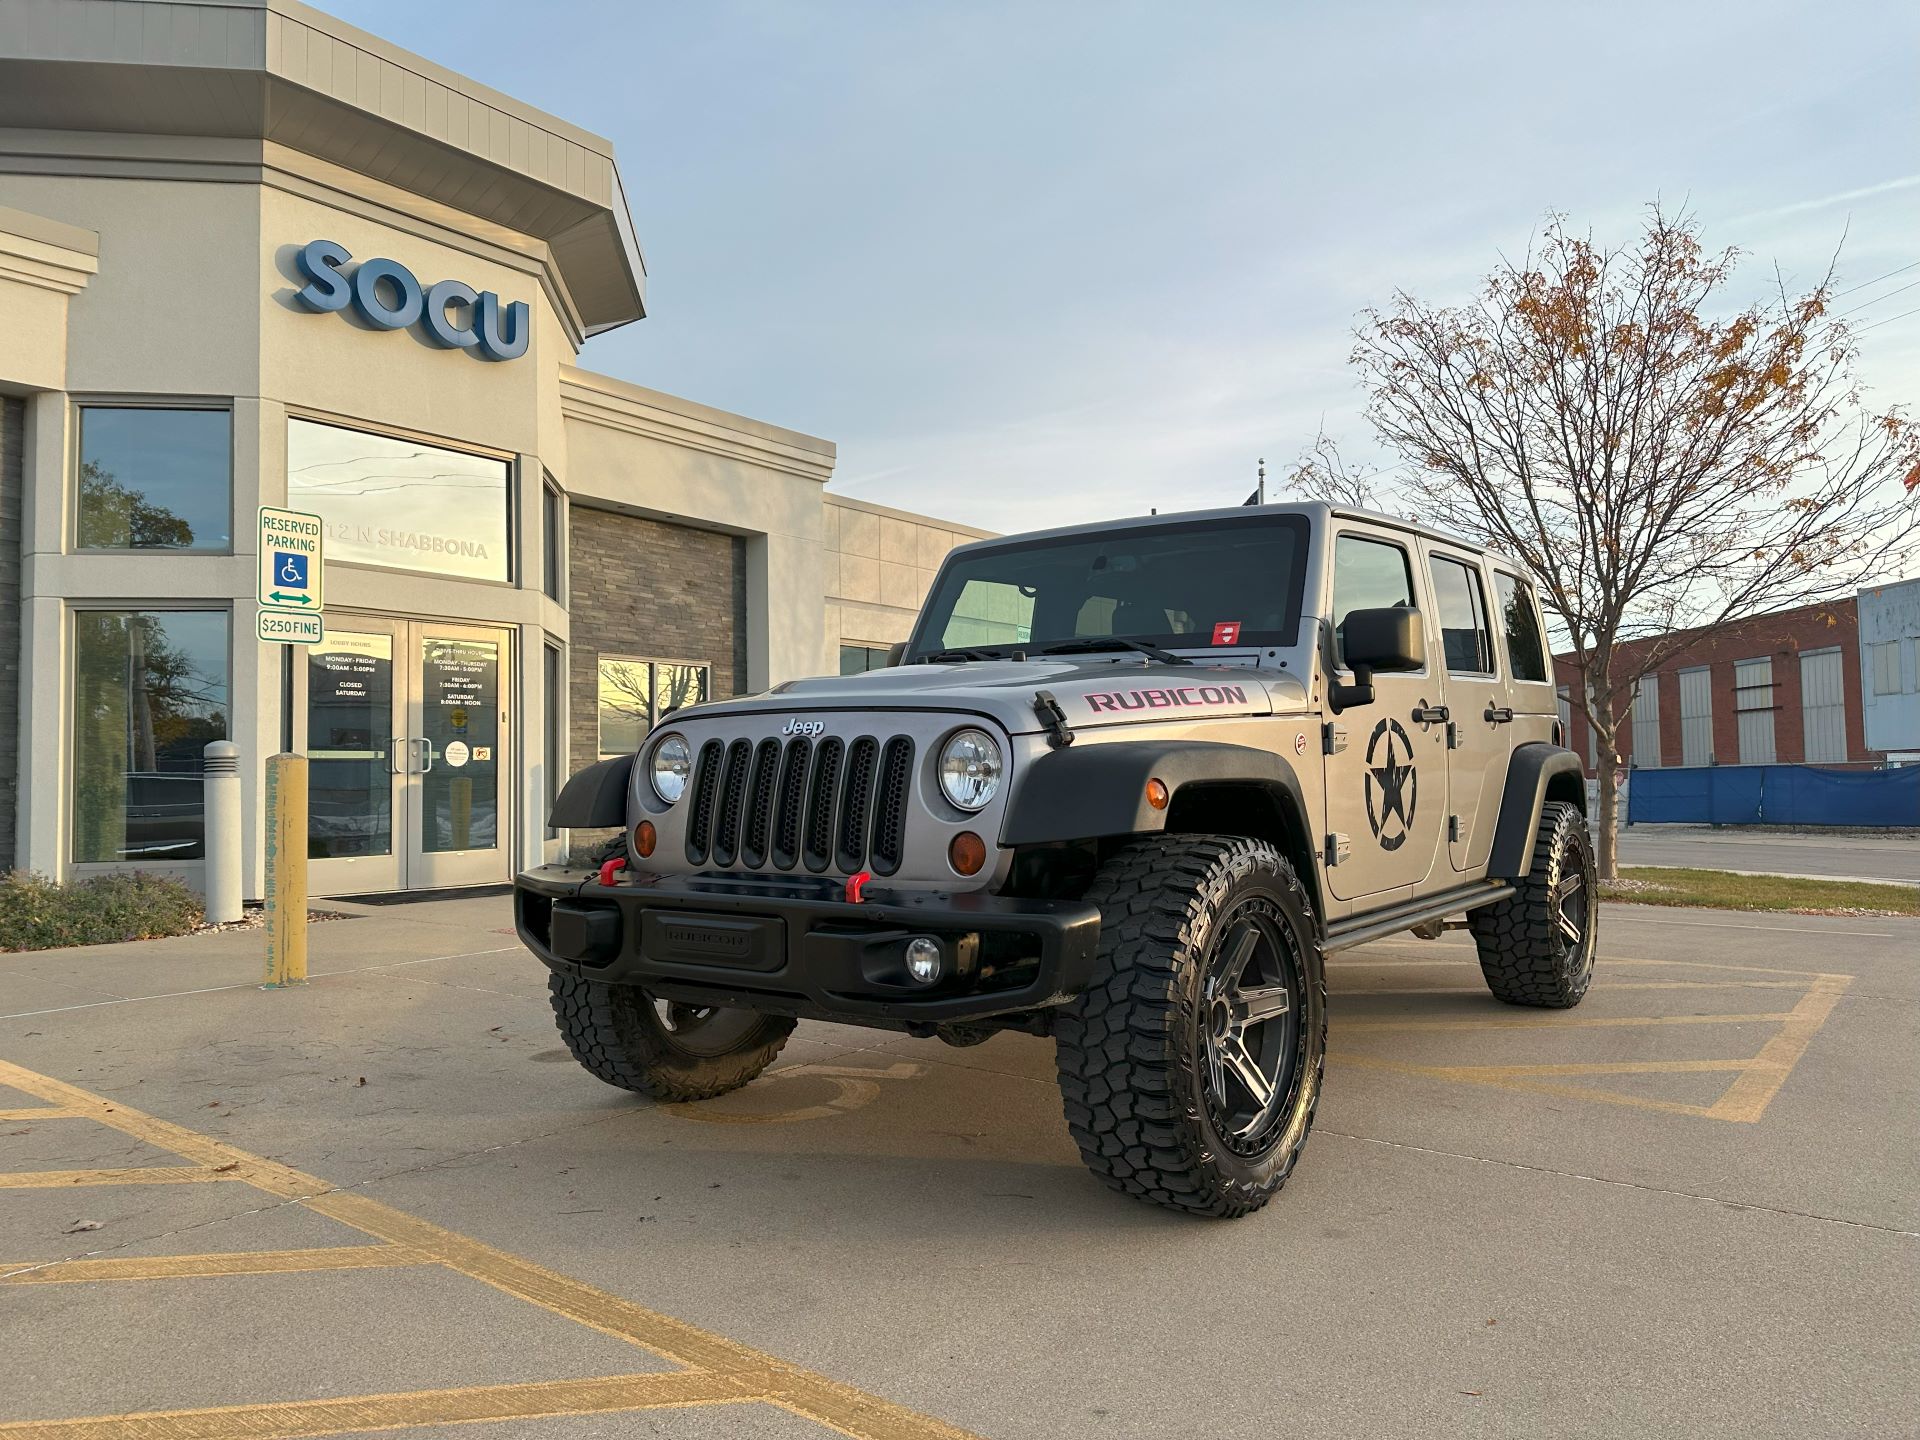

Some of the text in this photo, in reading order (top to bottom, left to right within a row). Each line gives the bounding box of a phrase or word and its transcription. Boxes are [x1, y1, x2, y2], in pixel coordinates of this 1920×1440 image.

[294, 240, 529, 361] SOCU
[263, 516, 318, 536] RESERVED
[267, 534, 315, 552] PARKING
[357, 526, 373, 543] N
[378, 528, 488, 560] SHABBONA
[262, 618, 319, 635] $250 FINE
[325, 655, 352, 663] MONDAY
[1083, 686, 1248, 713] RUBICON
[782, 717, 825, 738] Jeep
